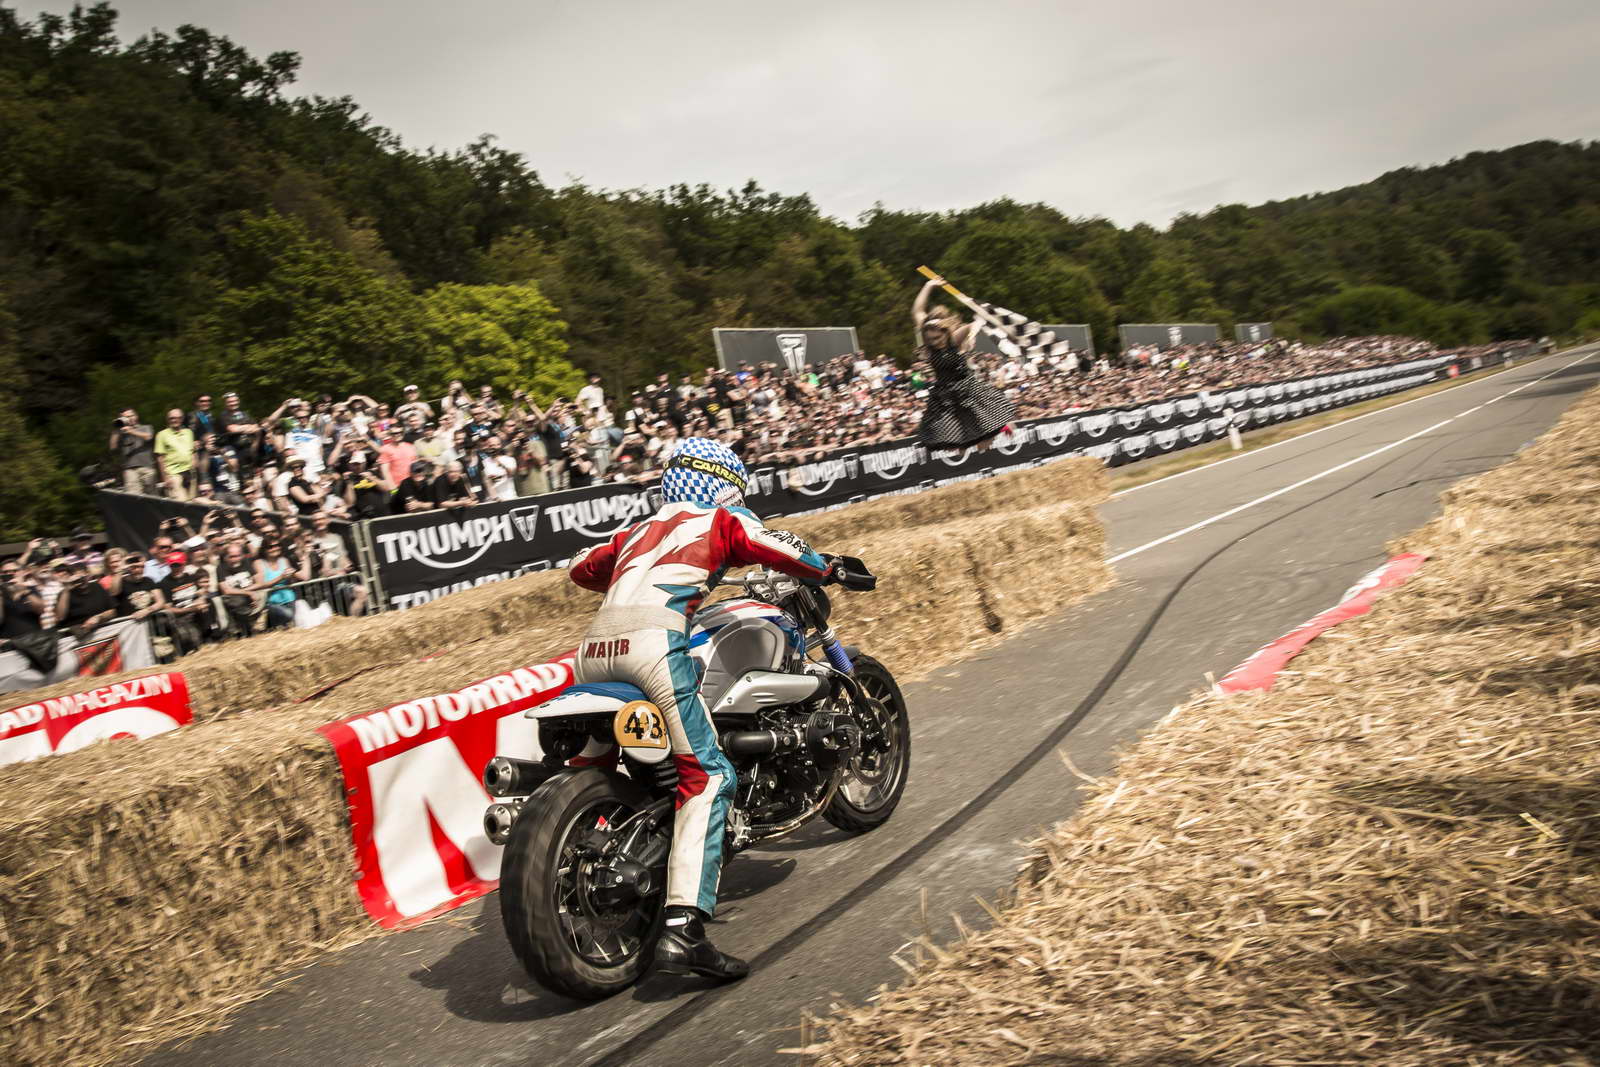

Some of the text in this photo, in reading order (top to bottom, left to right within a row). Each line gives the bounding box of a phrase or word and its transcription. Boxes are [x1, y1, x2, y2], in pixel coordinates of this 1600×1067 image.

[776, 458, 848, 496] TIUMPH
[543, 490, 651, 538] TRIUMPH
[376, 513, 515, 569] TRIUMPH
[585, 638, 630, 659] MAIER
[43, 673, 173, 720] MAGAZIN
[346, 662, 568, 754] MOTORRAD
